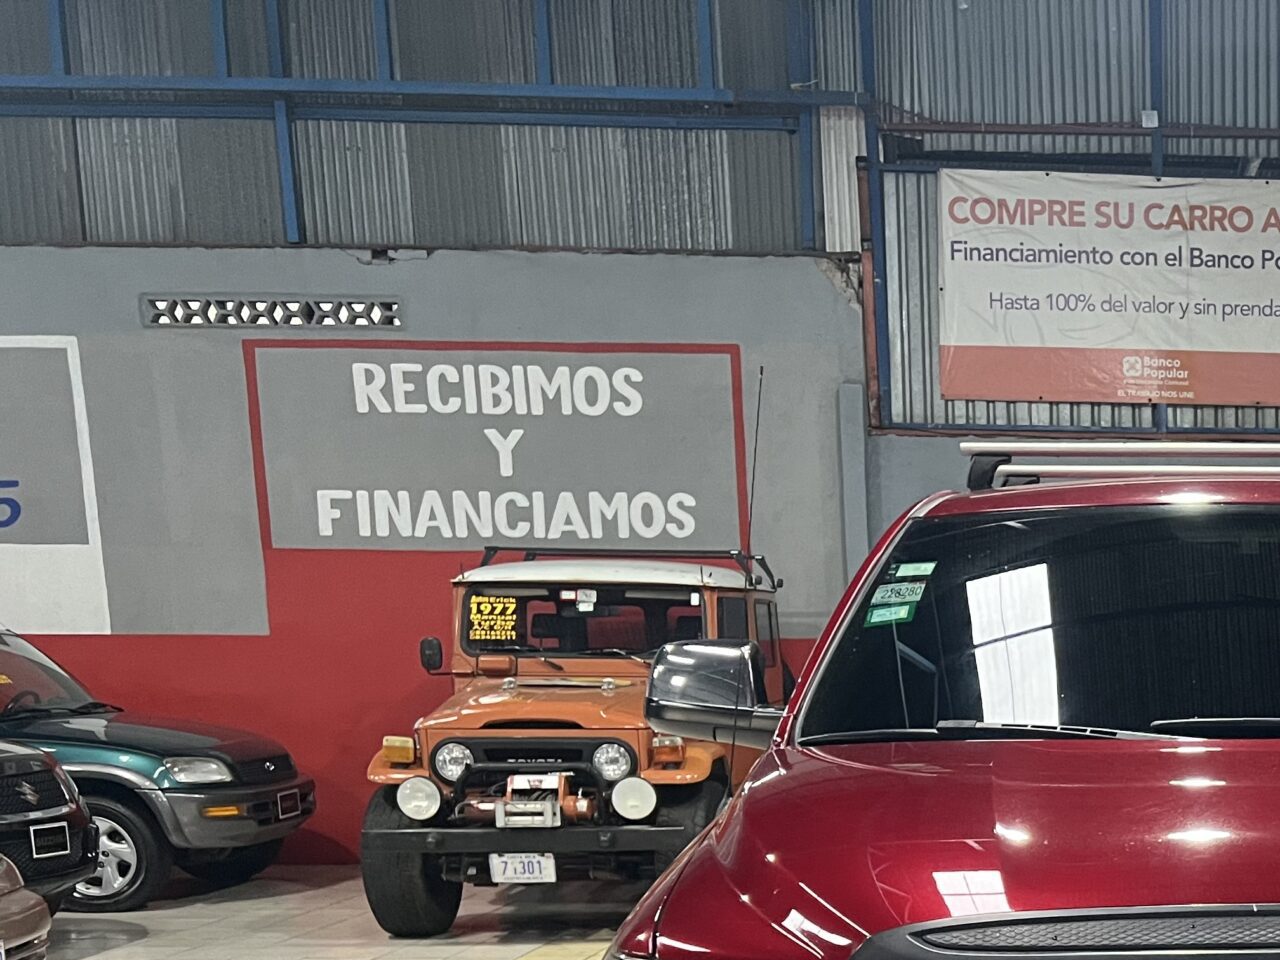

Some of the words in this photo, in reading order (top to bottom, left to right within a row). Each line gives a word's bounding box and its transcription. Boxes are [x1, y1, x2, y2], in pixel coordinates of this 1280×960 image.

[948, 196, 1086, 228] COMPRE
[1094, 200, 1135, 230] SU
[1143, 203, 1254, 233] CARRO
[950, 240, 1114, 266] Financiamiento
[1120, 251, 1158, 267] con
[1164, 245, 1183, 267] el
[1189, 247, 1255, 270] Banco
[989, 292, 1041, 311] Hasta
[1046, 293, 1096, 312] 100%
[1100, 294, 1128, 313] del
[1131, 296, 1175, 314] valor
[1179, 302, 1190, 320] y
[1194, 298, 1217, 315] sin
[1143, 356, 1181, 368] Banco
[1143, 368, 1189, 379] Popular
[351, 362, 644, 416] RECIBIMOS
[483, 428, 525, 477] Y
[316, 489, 696, 539] FINANCIAMOS
[470, 603, 516, 615] 1977
